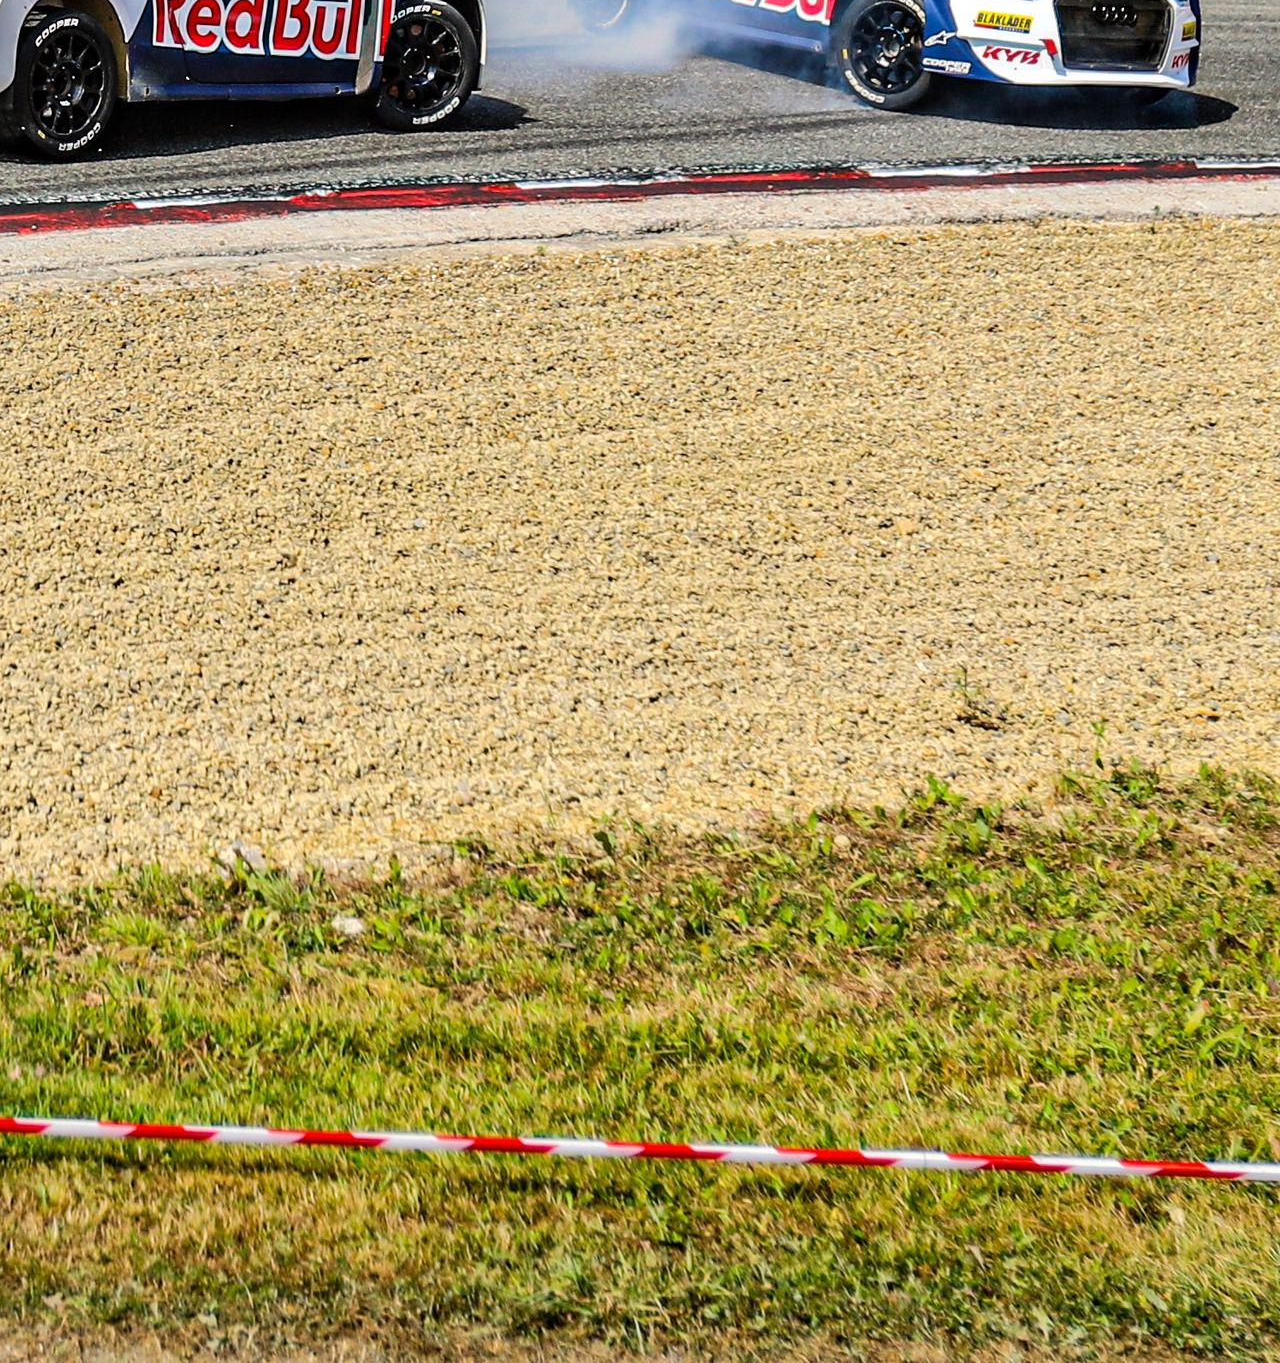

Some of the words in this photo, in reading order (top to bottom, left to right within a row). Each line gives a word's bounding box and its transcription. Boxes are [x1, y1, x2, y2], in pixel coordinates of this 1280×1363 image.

[390, 4, 431, 24] OOPER
[35, 17, 80, 47] COOPER
[922, 57, 971, 70] COOPER
[982, 44, 1040, 64] KYB
[412, 96, 460, 125] COOPER
[58, 122, 101, 151] COOPER
